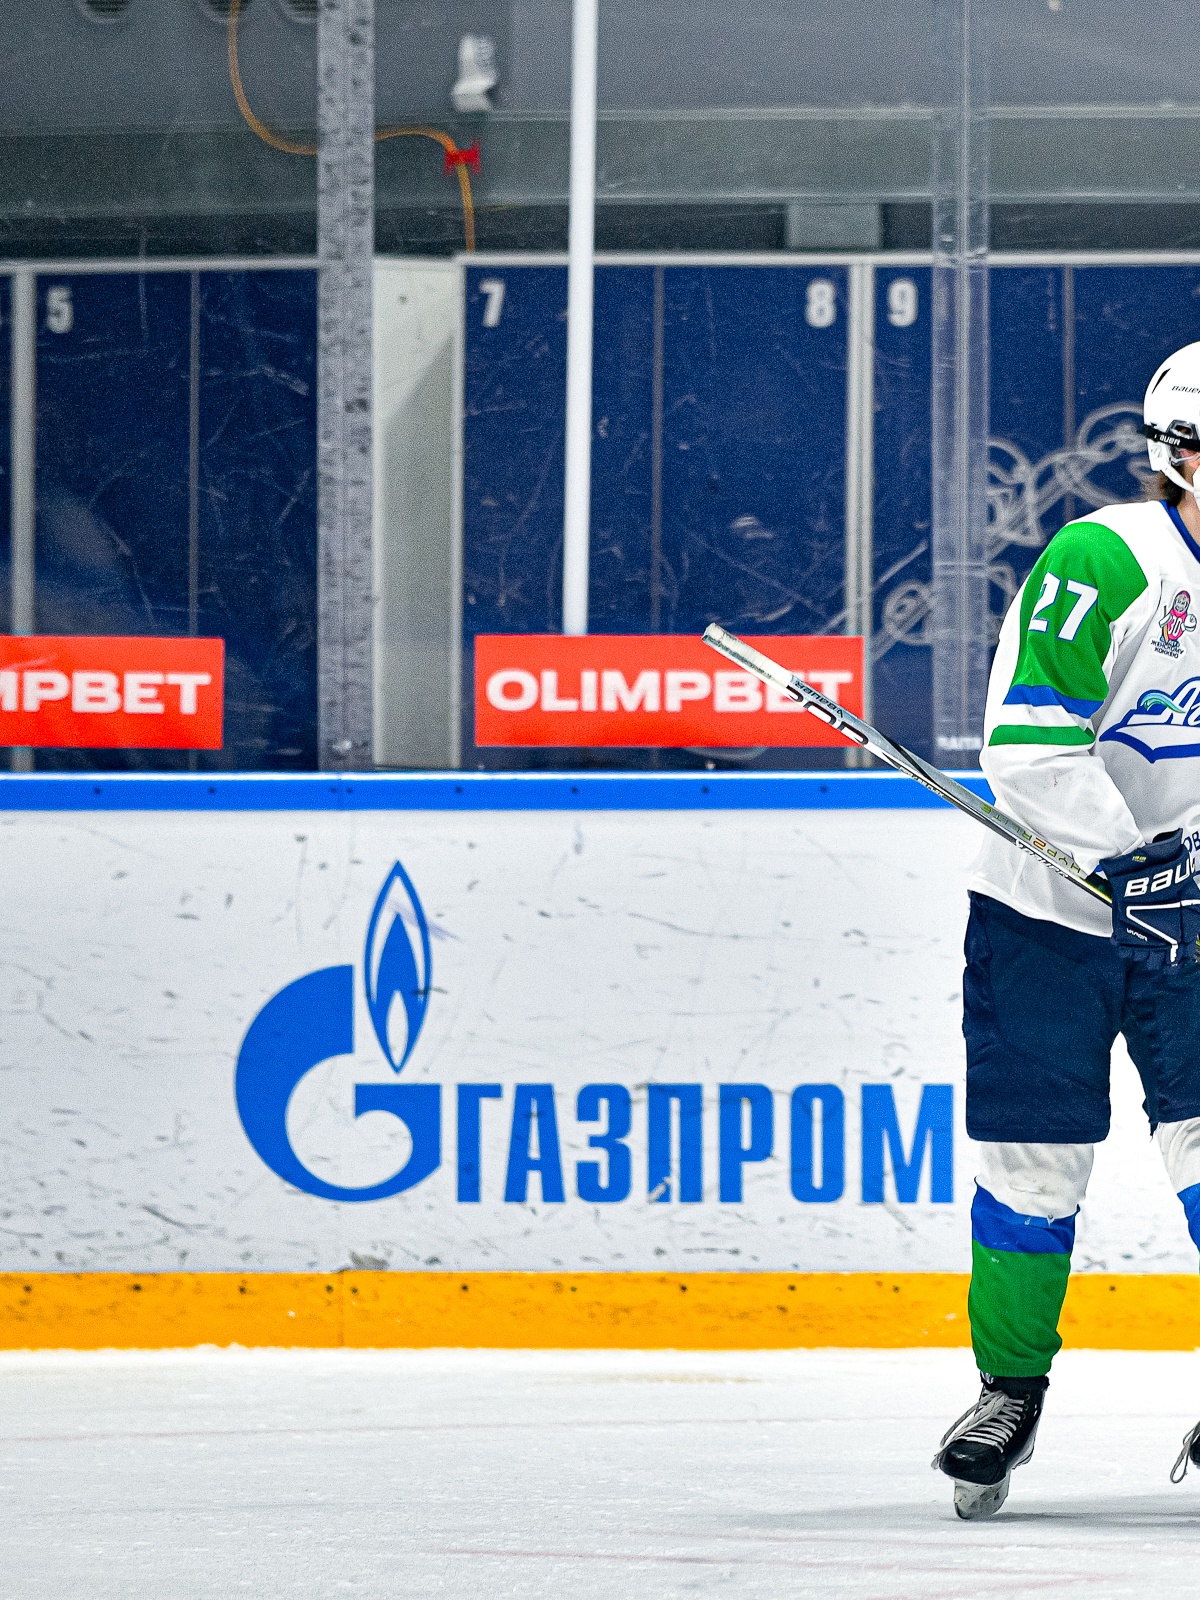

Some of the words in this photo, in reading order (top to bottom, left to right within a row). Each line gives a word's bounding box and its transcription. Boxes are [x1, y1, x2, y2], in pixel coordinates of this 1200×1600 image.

[46, 286, 74, 334] 5
[479, 278, 506, 328] 7
[805, 278, 837, 328] 8
[887, 278, 919, 327] 9
[1028, 571, 1098, 641] 27
[0, 669, 212, 715] PBET
[456, 1083, 956, 1205] ГАЗПРОМ
